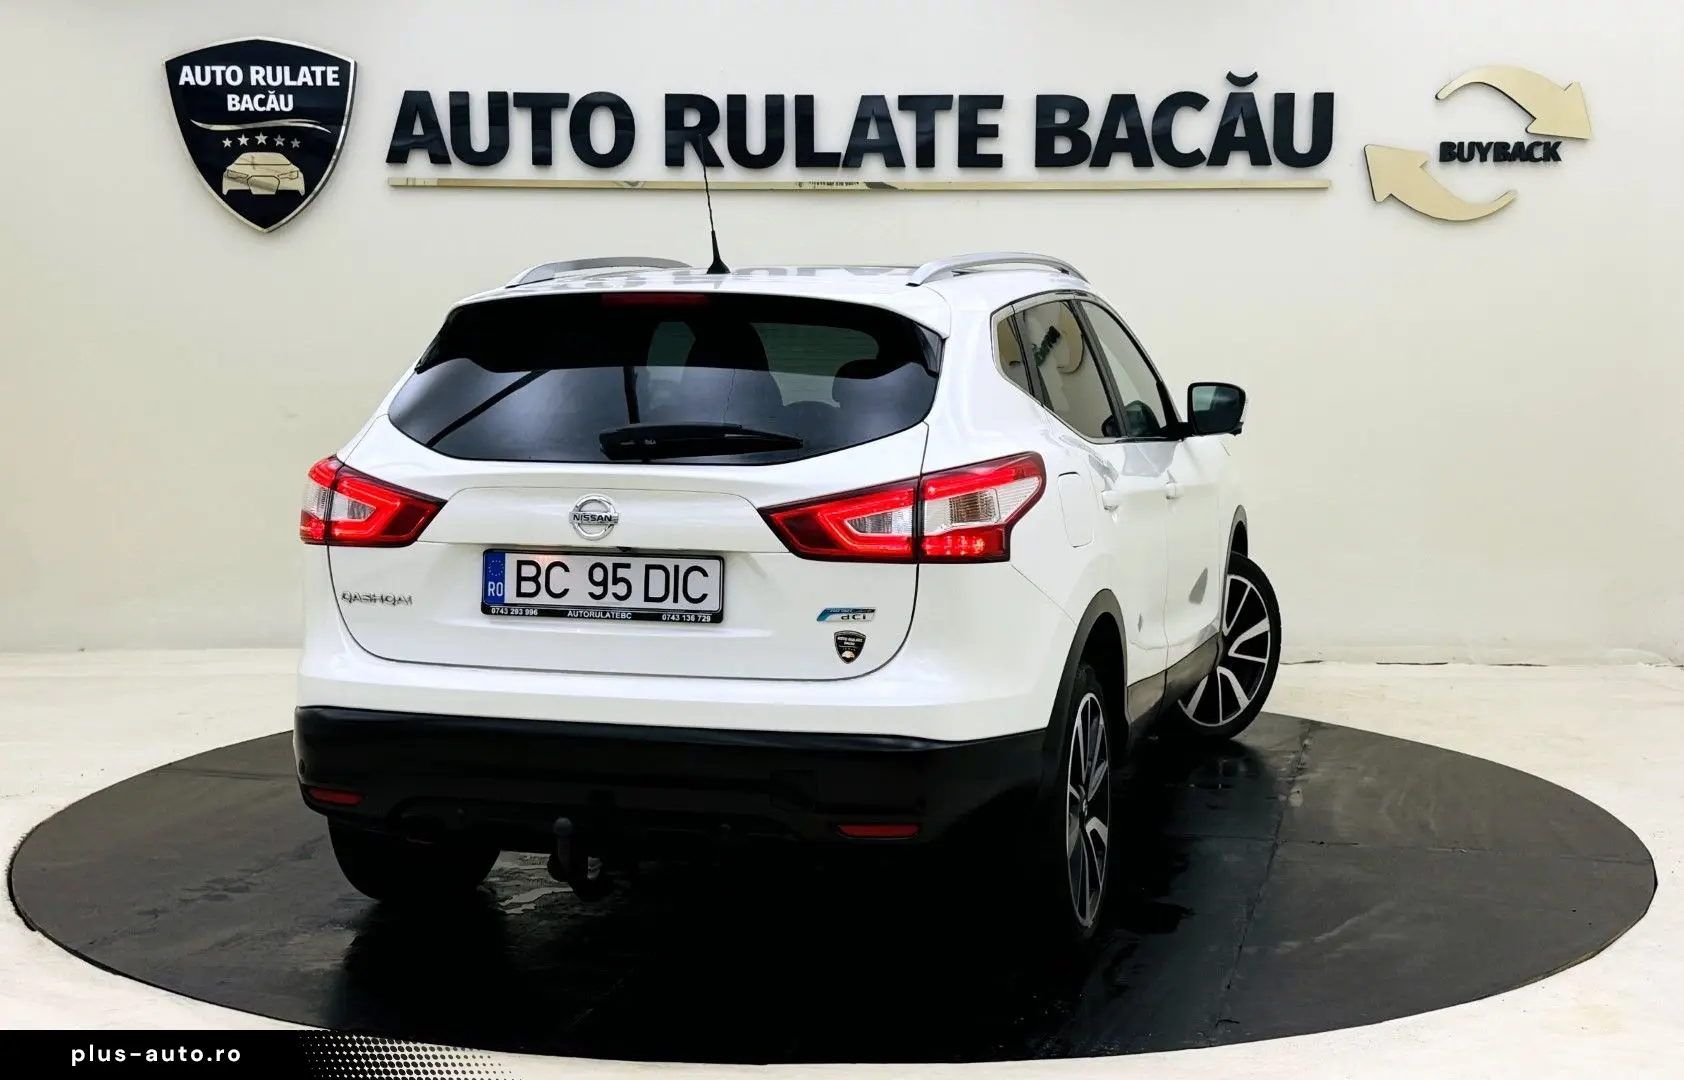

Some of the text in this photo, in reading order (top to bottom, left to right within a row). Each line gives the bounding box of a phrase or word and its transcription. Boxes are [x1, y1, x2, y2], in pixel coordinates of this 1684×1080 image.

[178, 65, 340, 87] AUTO RULATE
[226, 90, 294, 112] BACĂU
[385, 71, 1335, 169] AUTO RULATE BACĂU
[1439, 141, 1563, 163] BUYBACK
[573, 514, 613, 522] NISSAN
[487, 581, 504, 597] RO
[515, 559, 709, 605] BC 95 DIC
[340, 591, 413, 606] QASHQAI
[491, 607, 509, 615] 0743
[567, 610, 632, 620] AUTORULATEBC
[840, 613, 867, 621] dCi
